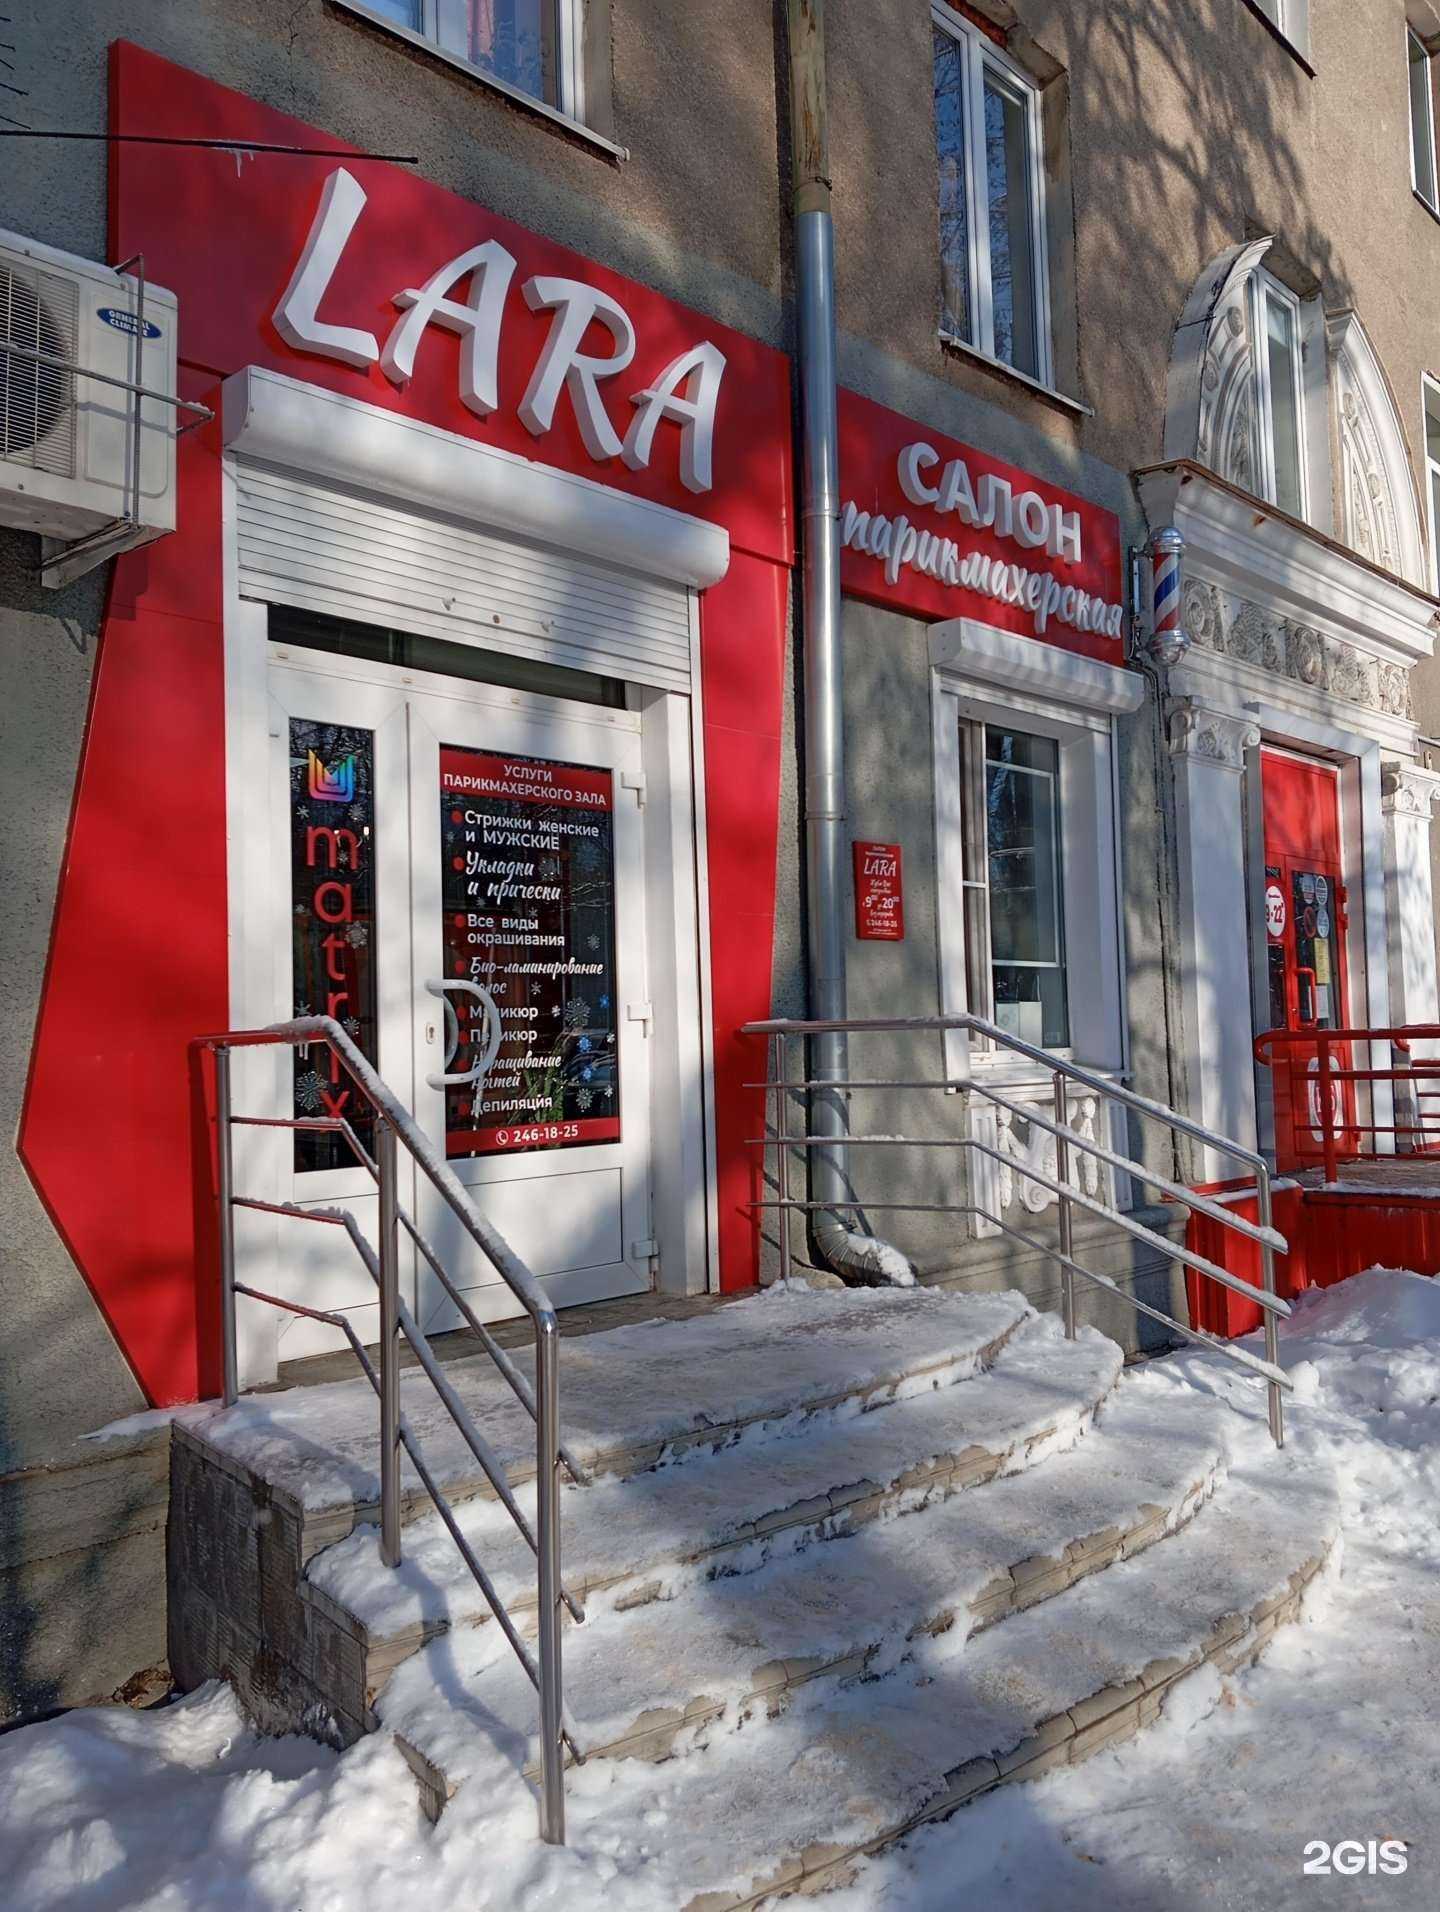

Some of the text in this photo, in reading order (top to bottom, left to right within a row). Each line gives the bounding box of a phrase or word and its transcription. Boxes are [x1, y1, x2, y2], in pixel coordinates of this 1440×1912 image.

[109, 318, 148, 337] CLIMAE
[271, 166, 727, 495] LARA
[897, 441, 1082, 565] САЛОН
[841, 500, 1124, 641] парикмахерская
[503, 764, 553, 783] УСЛУГИ
[443, 773, 607, 806] ПАРИКМАХЕРСКОГО ЗАЛА
[464, 810, 600, 837] Стрижки женские
[465, 830, 560, 850] и МУЖСКИЕ
[466, 850, 534, 883] Укладки
[863, 858, 897, 877] LARA
[467, 881, 561, 905] и прически
[467, 914, 539, 930] Все виды
[467, 931, 565, 947] окрашивания
[470, 956, 604, 980] Био-ламинирование
[469, 1004, 539, 1022] Микюр
[470, 1028, 538, 1044] Пеикюр
[472, 1050, 562, 1075] Нращивание
[513, 1125, 579, 1143] 246-18-25
